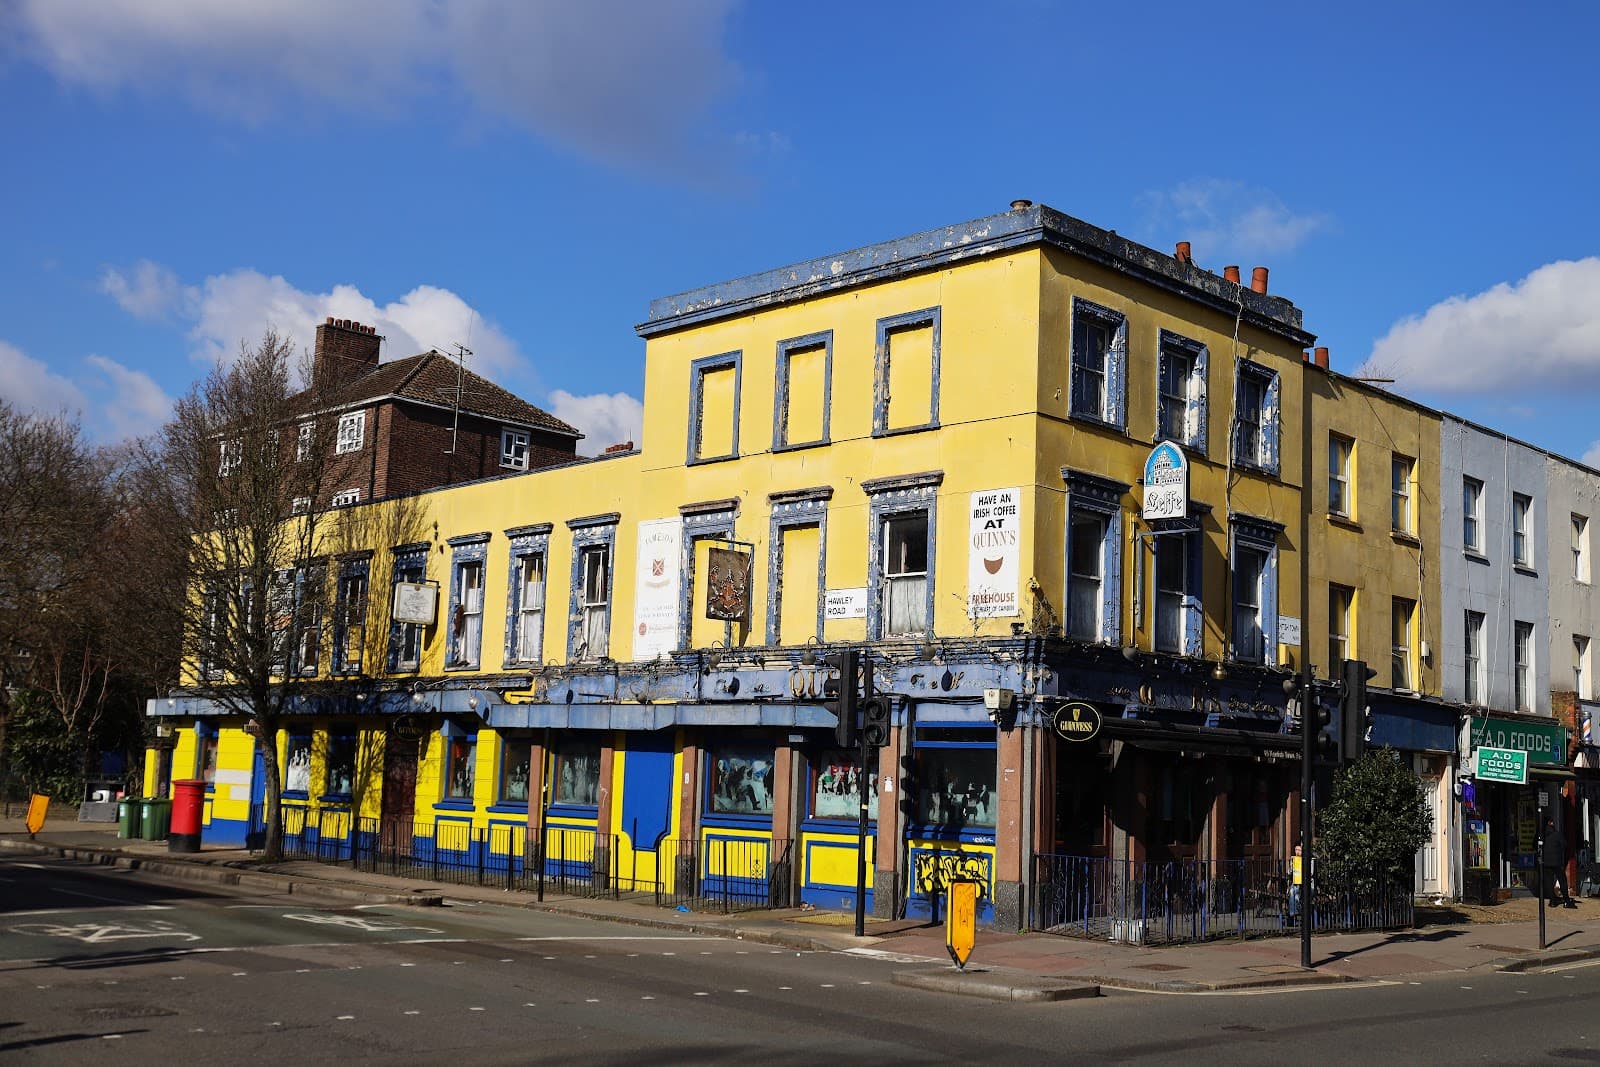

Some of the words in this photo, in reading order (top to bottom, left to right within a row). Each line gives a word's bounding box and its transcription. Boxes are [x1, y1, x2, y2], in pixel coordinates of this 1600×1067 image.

[978, 495, 997, 506] HAVE
[1000, 493, 1011, 503] AN
[1144, 491, 1182, 514] Leffe
[973, 508, 990, 519] IRISH
[993, 505, 1016, 516] COFFEE
[984, 518, 1005, 530] AT
[973, 530, 1016, 551] QUINN'S
[827, 596, 853, 606] HAWLEY
[827, 607, 846, 616] ROAD
[1060, 720, 1093, 732] GUINNESS
[1510, 732, 1550, 752] FOODS
[1492, 752, 1512, 760] A.D
[1481, 759, 1521, 770] FOODS
